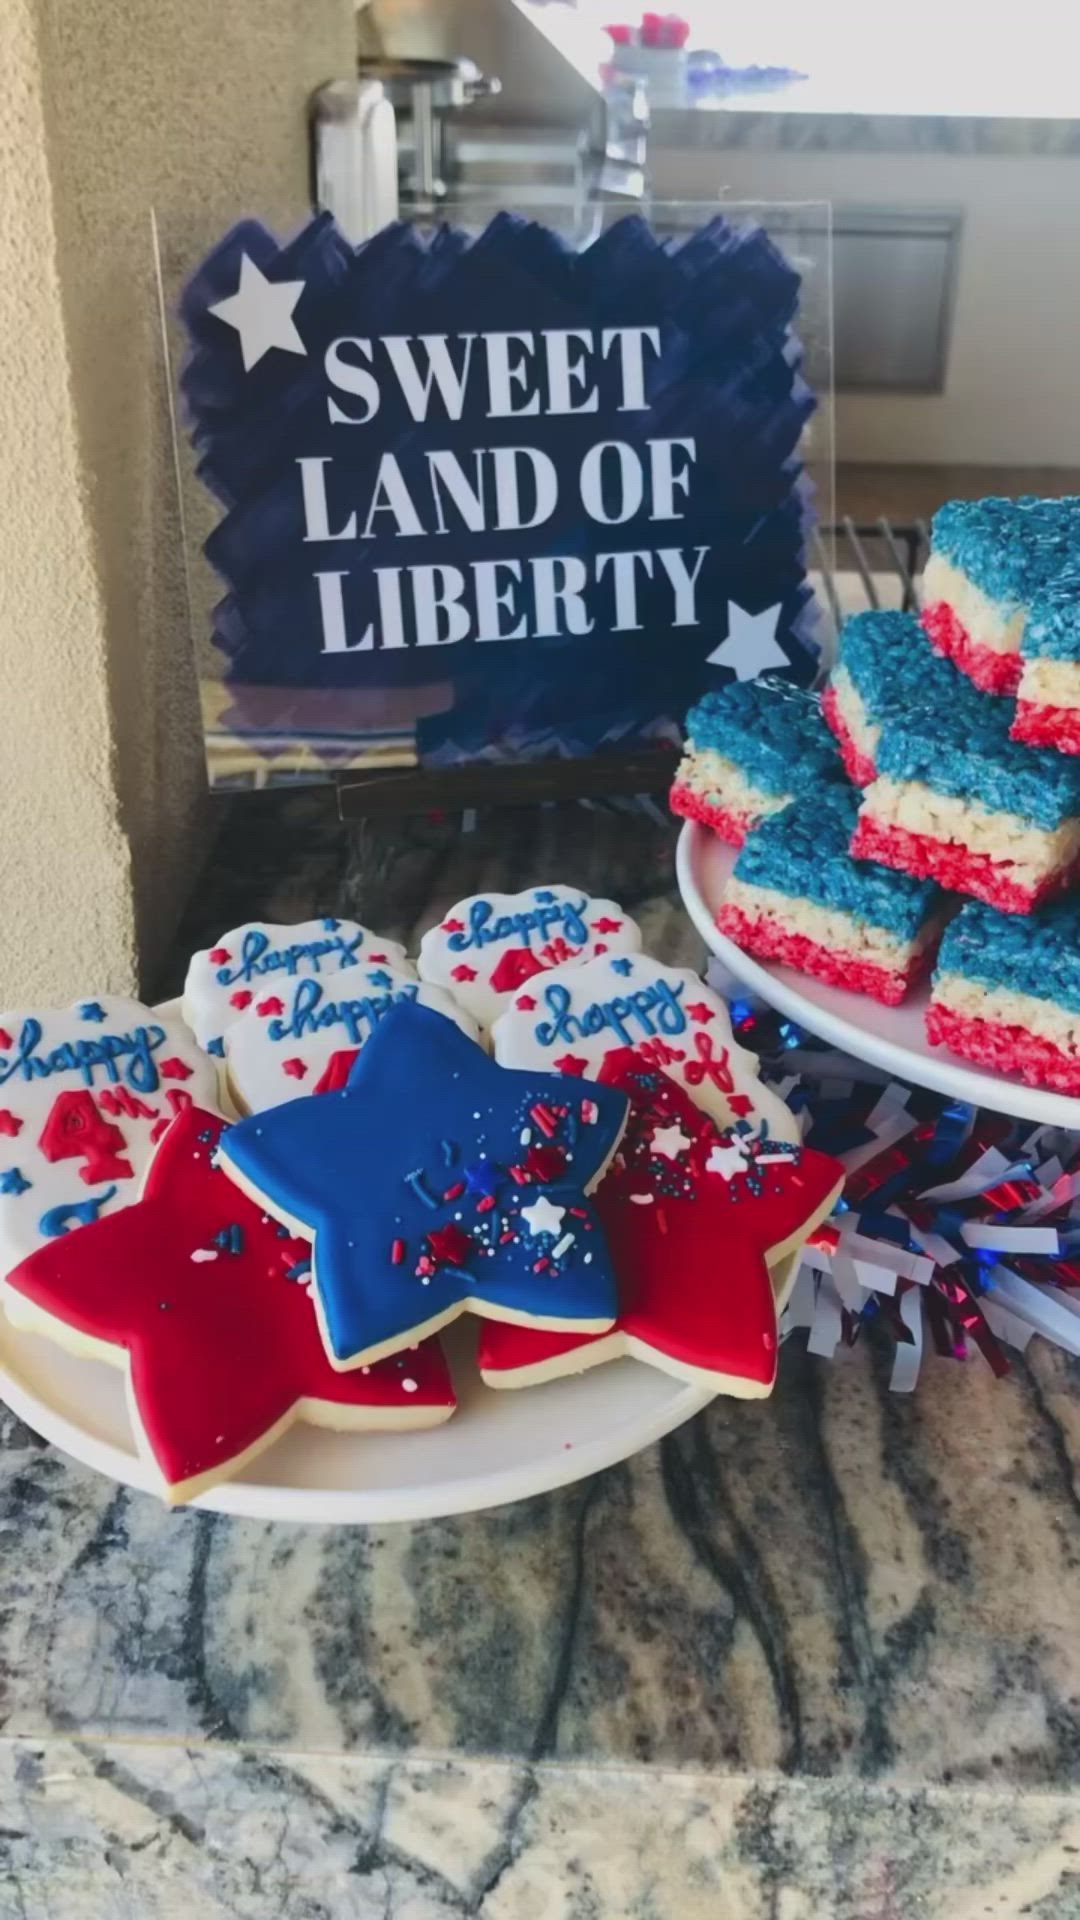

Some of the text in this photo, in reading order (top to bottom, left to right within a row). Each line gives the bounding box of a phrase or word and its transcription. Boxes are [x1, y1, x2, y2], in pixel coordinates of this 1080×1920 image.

[324, 326, 662, 424] SWEET
[295, 438, 697, 542] LAND OF
[313, 546, 711, 654] LIBERTY
[216, 931, 363, 986] happy
[447, 898, 589, 953] happy
[535, 979, 685, 1046] happy
[0, 1018, 167, 1093] happy
[684, 1032, 735, 1093] of
[38, 1085, 160, 1185] 4th
